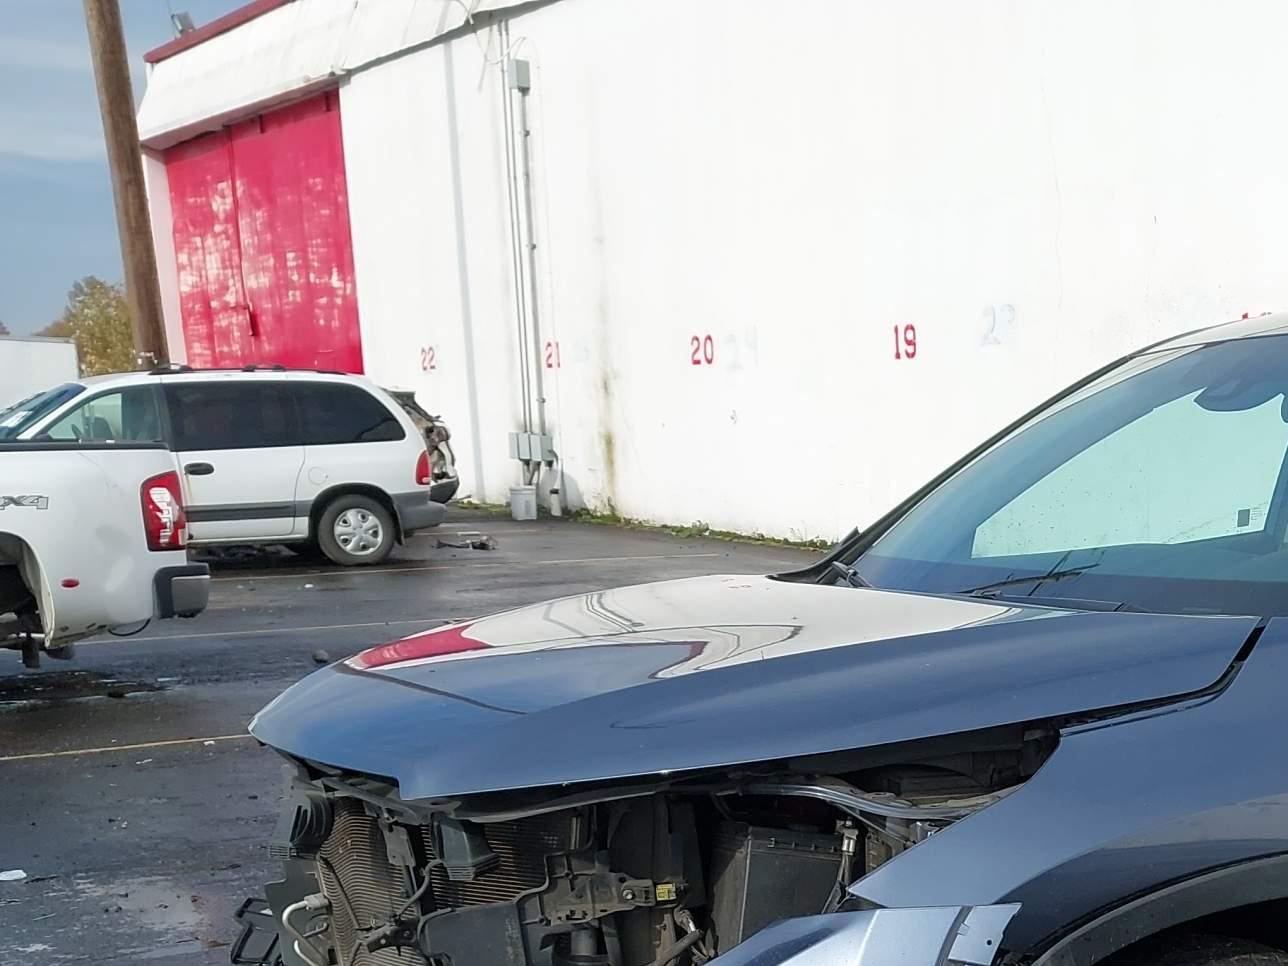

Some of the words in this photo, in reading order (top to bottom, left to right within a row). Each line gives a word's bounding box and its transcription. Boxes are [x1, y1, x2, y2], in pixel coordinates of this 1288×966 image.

[545, 341, 561, 368] 21
[690, 334, 714, 365] 20
[894, 323, 916, 360] 19
[421, 346, 436, 371] 22
